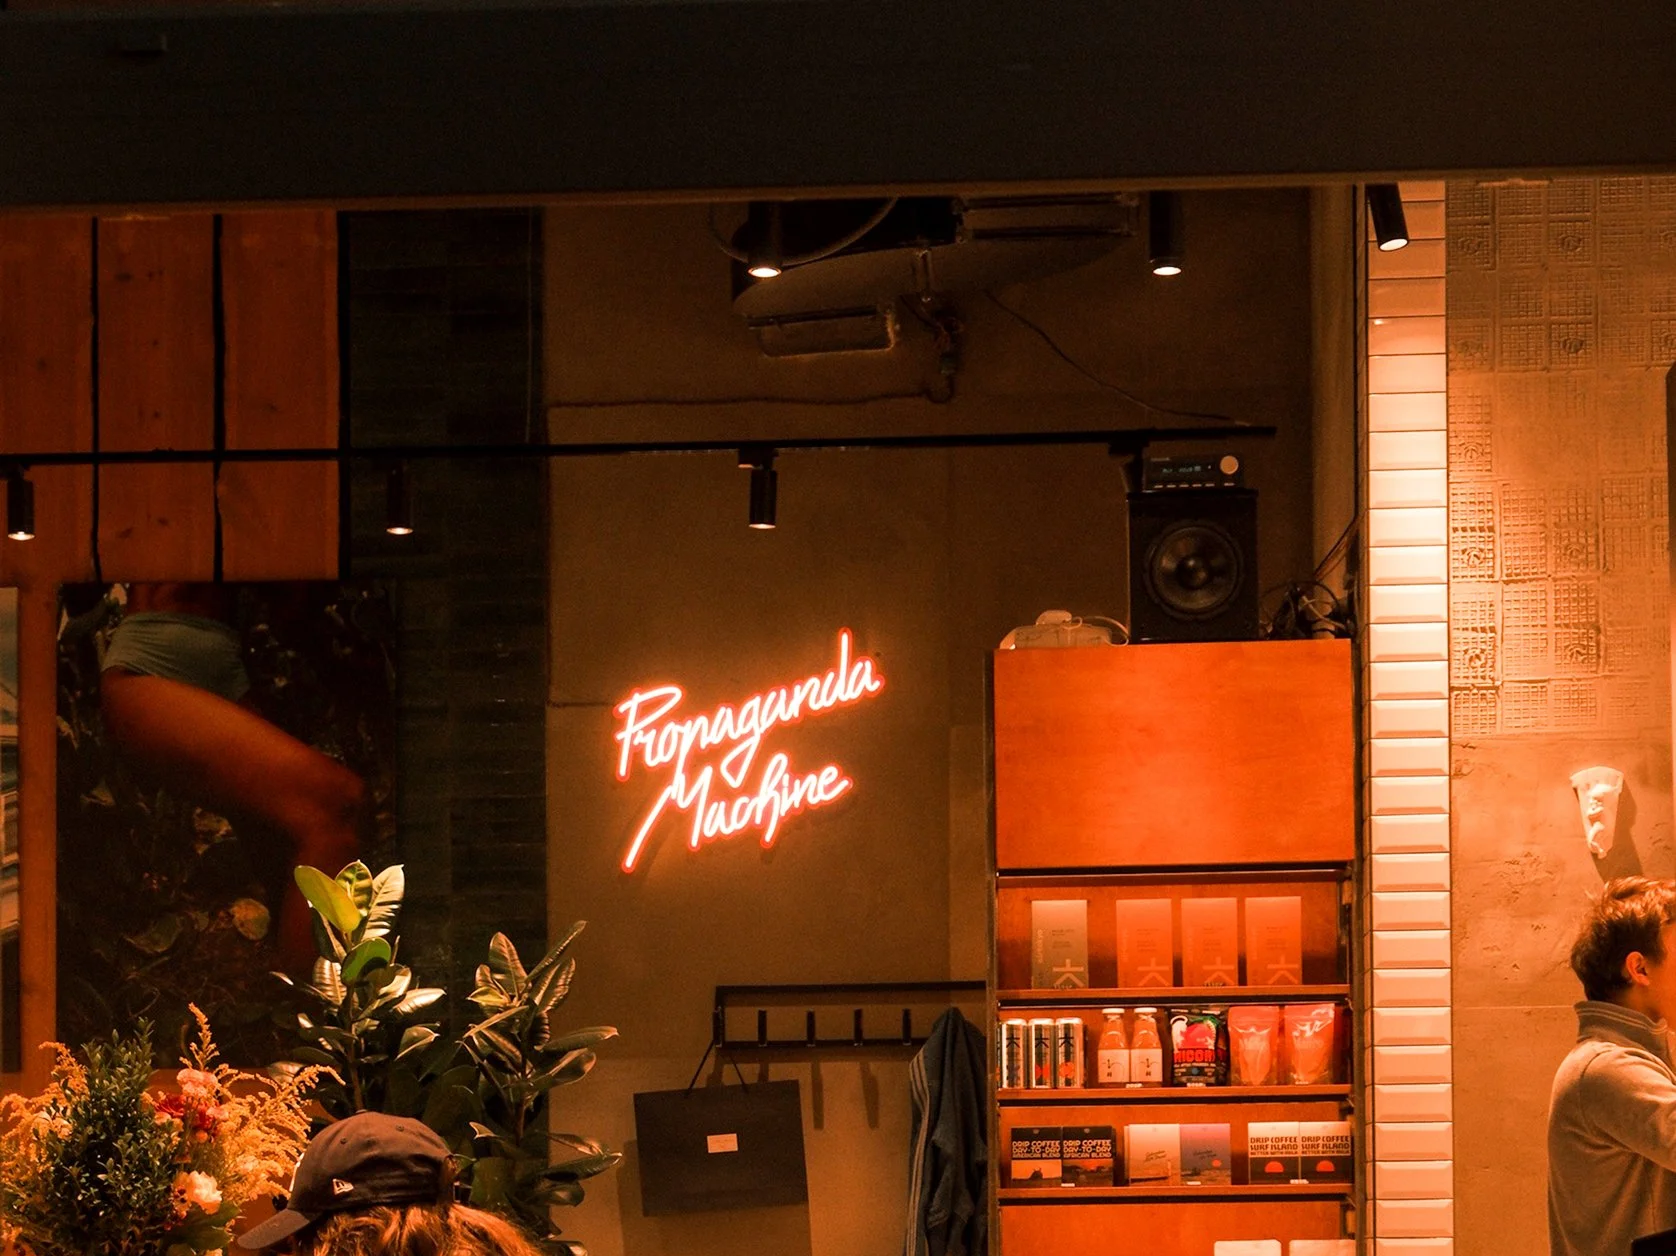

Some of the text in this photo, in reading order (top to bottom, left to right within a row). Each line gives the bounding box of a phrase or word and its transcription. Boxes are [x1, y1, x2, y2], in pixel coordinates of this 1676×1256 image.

[614, 629, 884, 796] Propaganda
[622, 752, 853, 872] Machine
[1250, 1143, 1270, 1151] SURF
[1322, 1142, 1350, 1150] ISLAND
